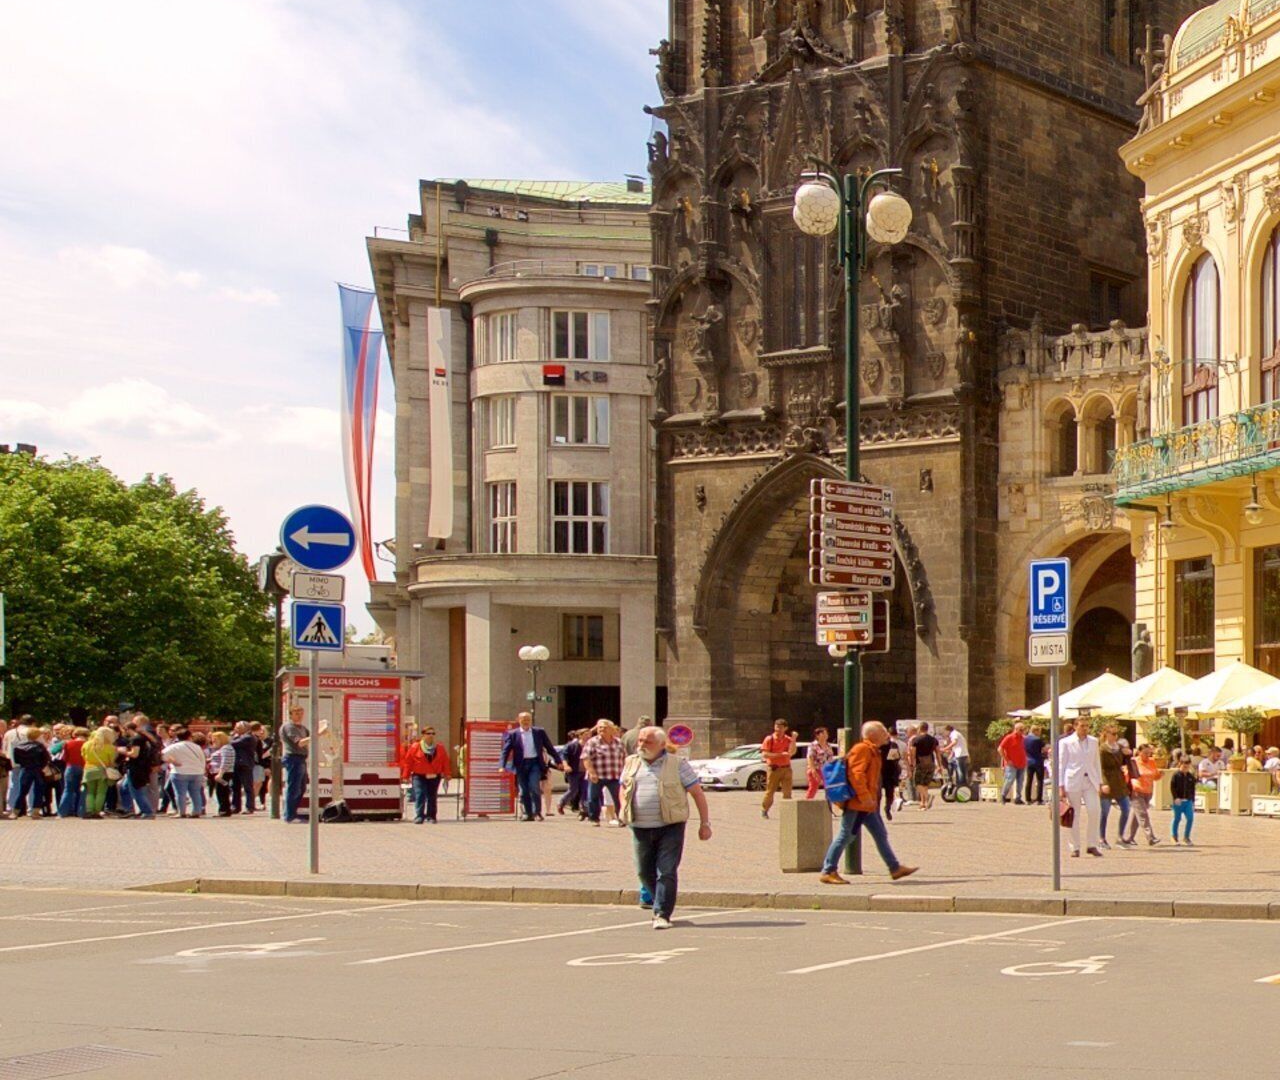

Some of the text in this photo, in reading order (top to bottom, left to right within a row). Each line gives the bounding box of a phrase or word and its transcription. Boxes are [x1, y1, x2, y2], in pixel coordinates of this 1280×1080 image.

[574, 370, 608, 384] KB
[309, 576, 329, 585] MIMO
[1038, 569, 1060, 610] P
[1033, 646, 1038, 657] 3
[357, 788, 389, 796] TOUR
